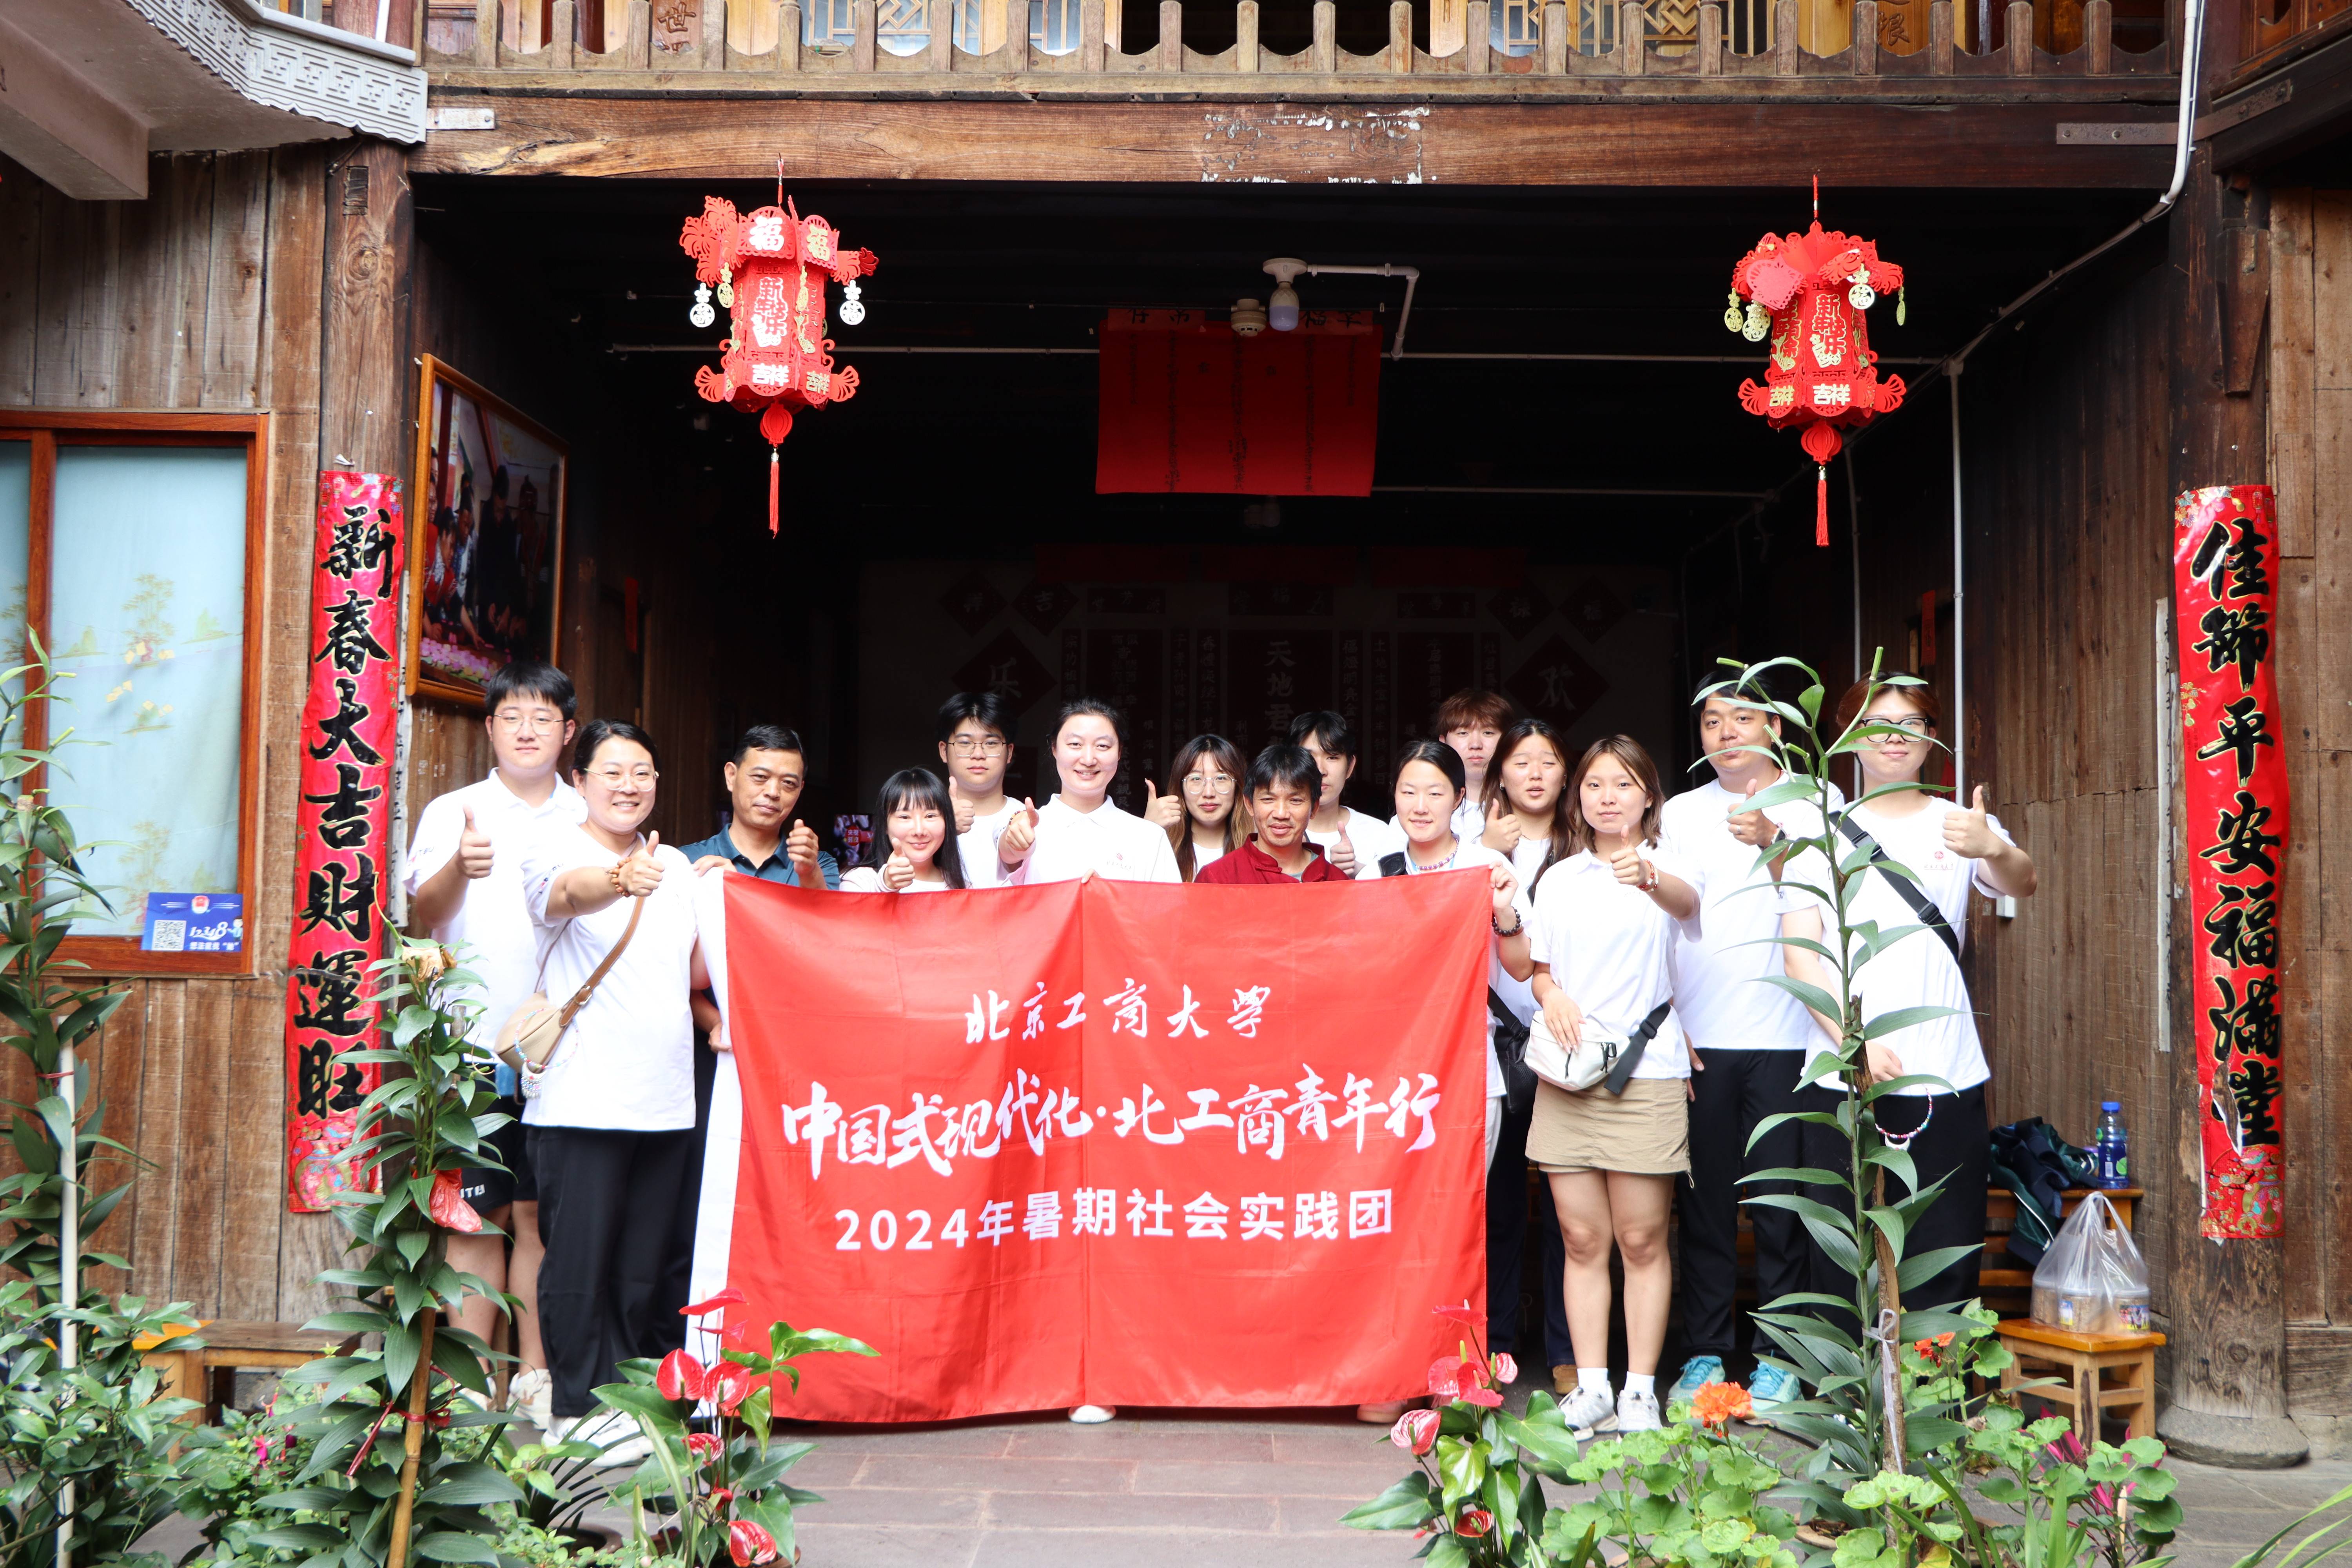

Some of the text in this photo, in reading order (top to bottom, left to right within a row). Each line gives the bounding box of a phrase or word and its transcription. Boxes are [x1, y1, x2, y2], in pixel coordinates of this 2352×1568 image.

[750, 216, 784, 251] 福
[806, 225, 831, 260] 福
[752, 363, 789, 387] 吉祥
[806, 370, 831, 395] 吉祥
[1769, 385, 1794, 407] 吉祥
[1813, 383, 1850, 406] 吉祥
[835, 1187, 1394, 1252] 2024年暑期社会实践团
